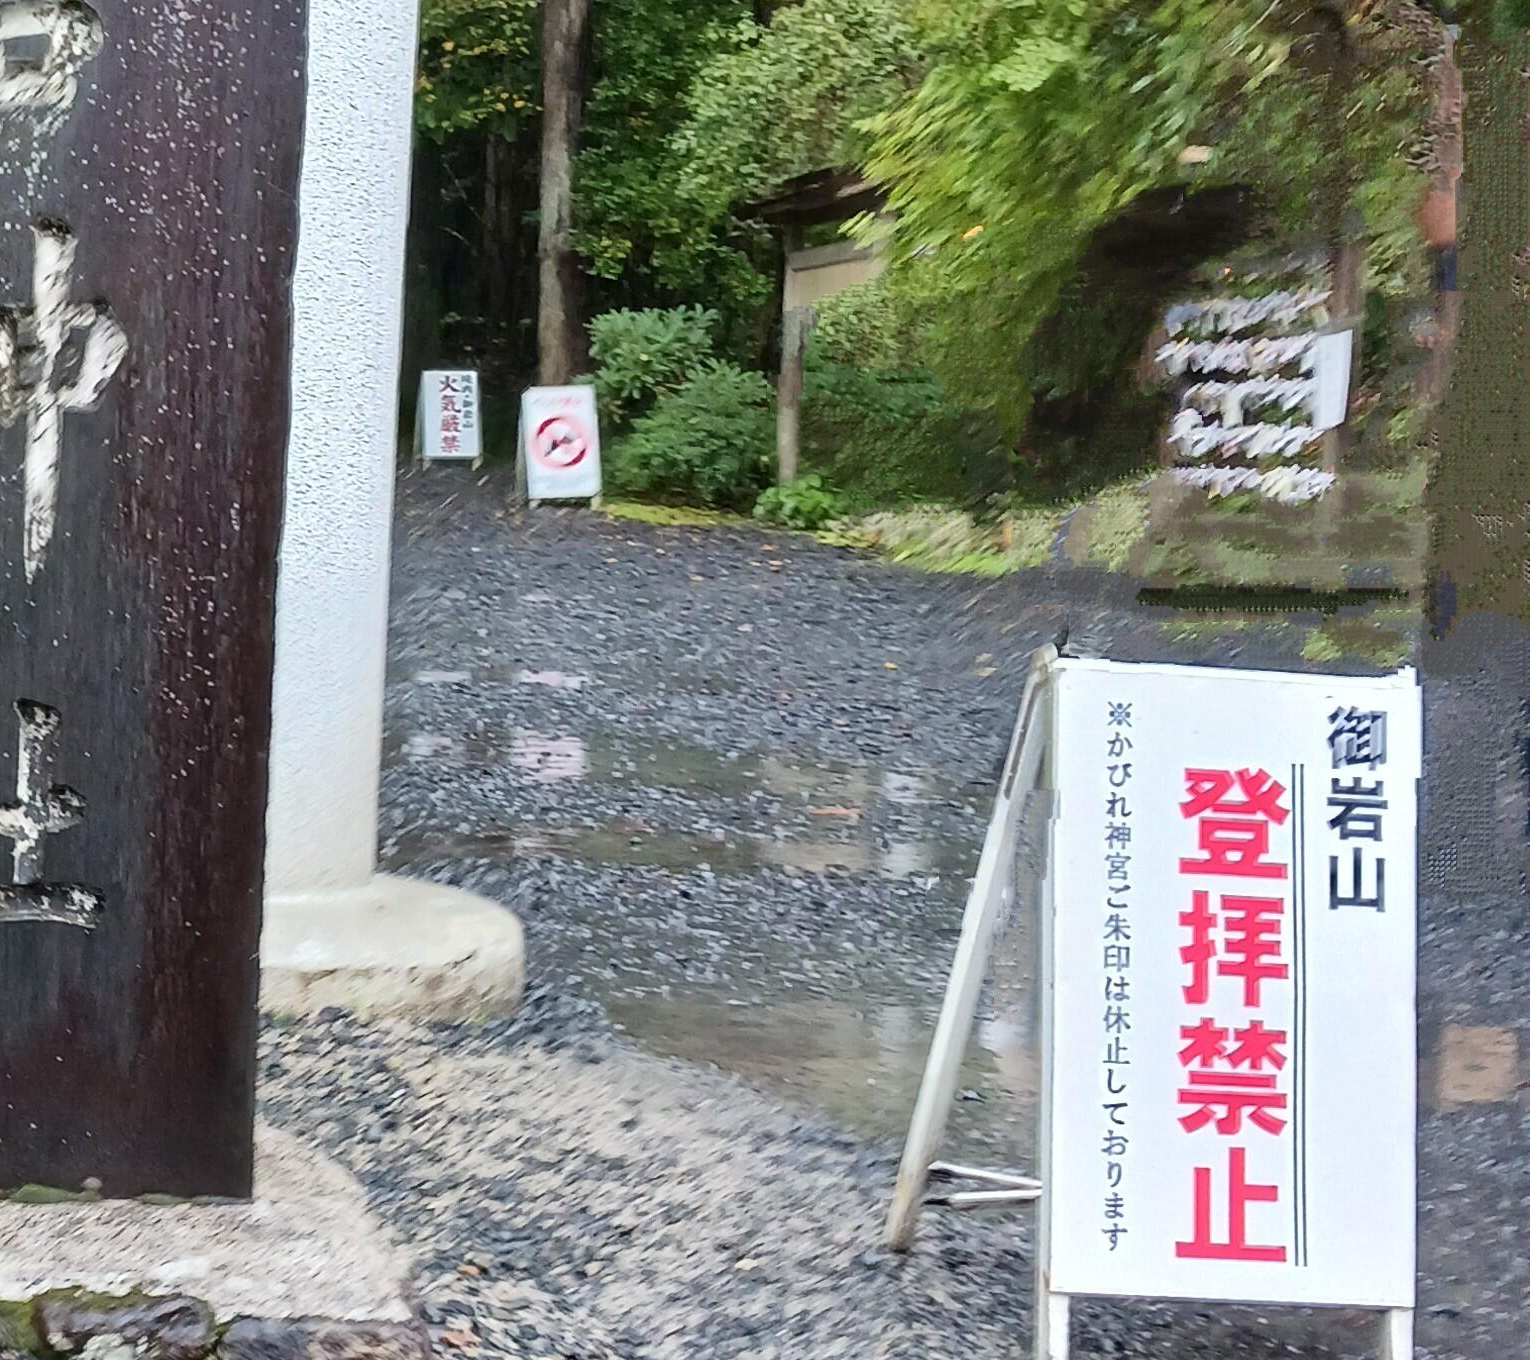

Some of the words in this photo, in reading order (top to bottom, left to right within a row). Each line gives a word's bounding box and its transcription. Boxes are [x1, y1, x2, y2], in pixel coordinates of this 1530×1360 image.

[1326, 705, 1389, 913] 御岩山
[1175, 767, 1290, 1263] 登拝禁止
